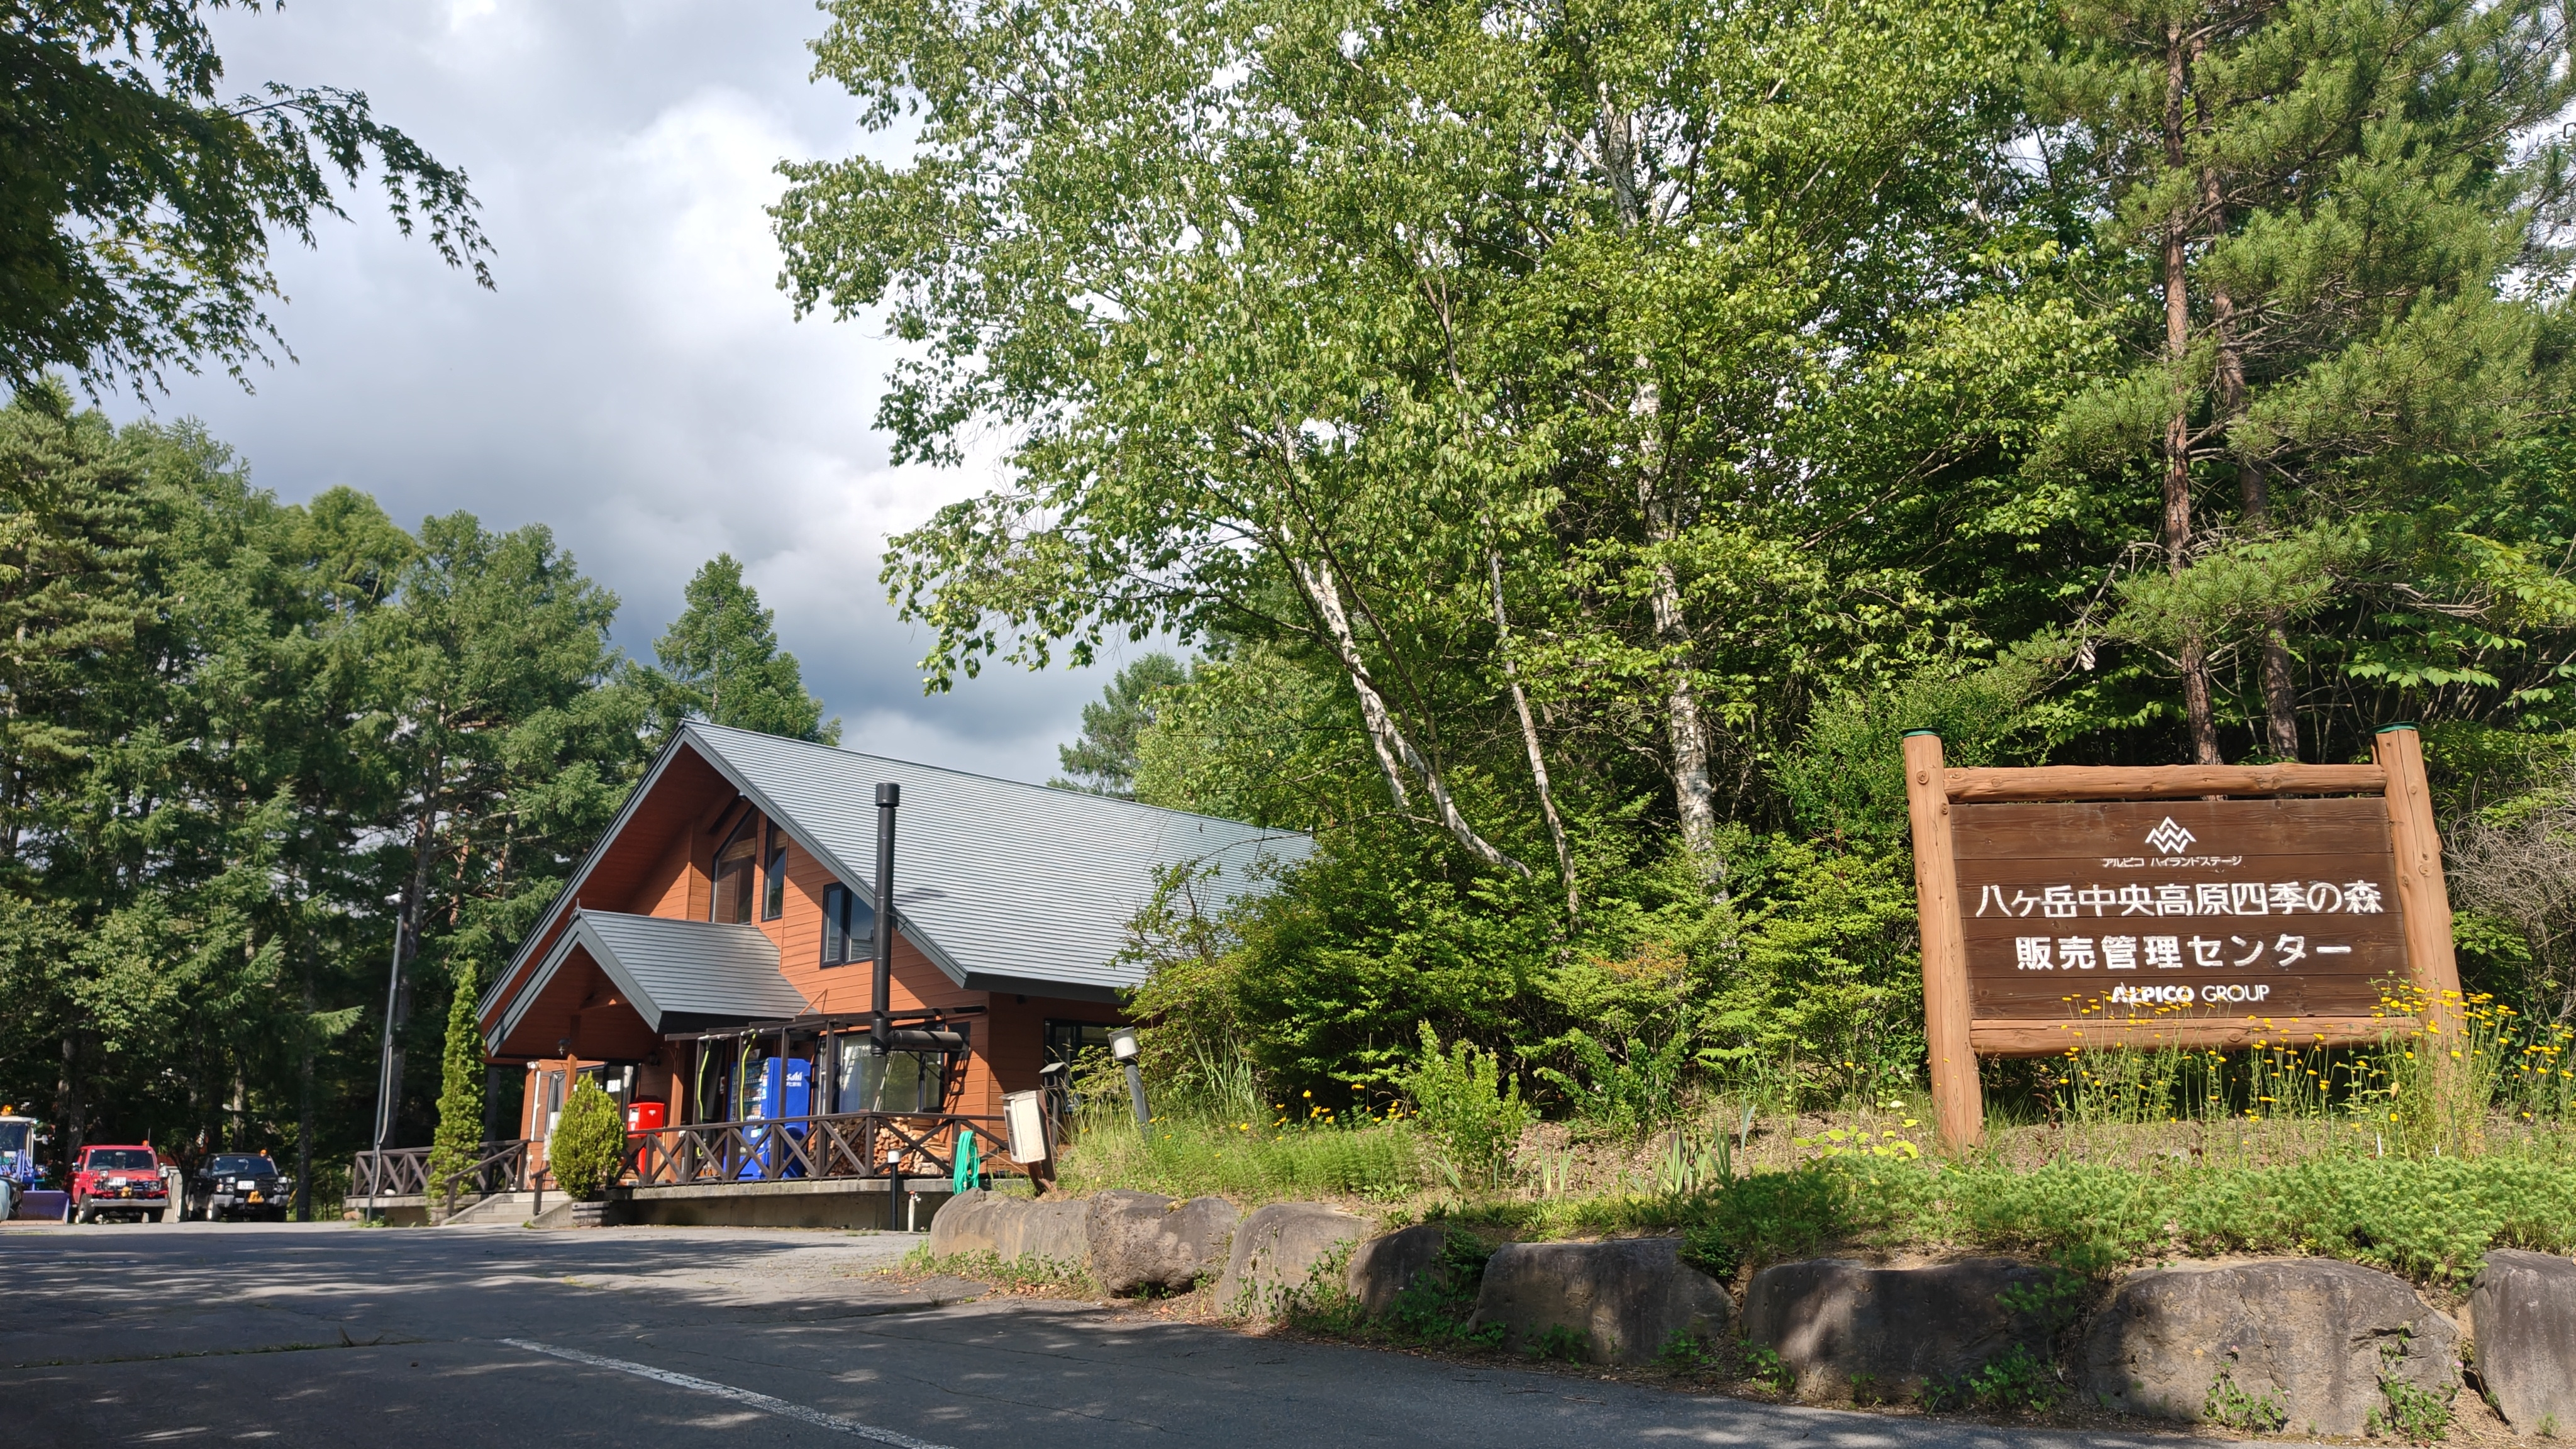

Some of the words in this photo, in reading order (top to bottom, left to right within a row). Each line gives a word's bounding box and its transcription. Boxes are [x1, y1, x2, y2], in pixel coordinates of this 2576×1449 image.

[2150, 855, 2242, 866] ハイランドステージ
[2014, 934, 2351, 970] 販売管理センター
[2111, 985, 2195, 1003] ALPICO
[2201, 984, 2270, 1002] GROUP
